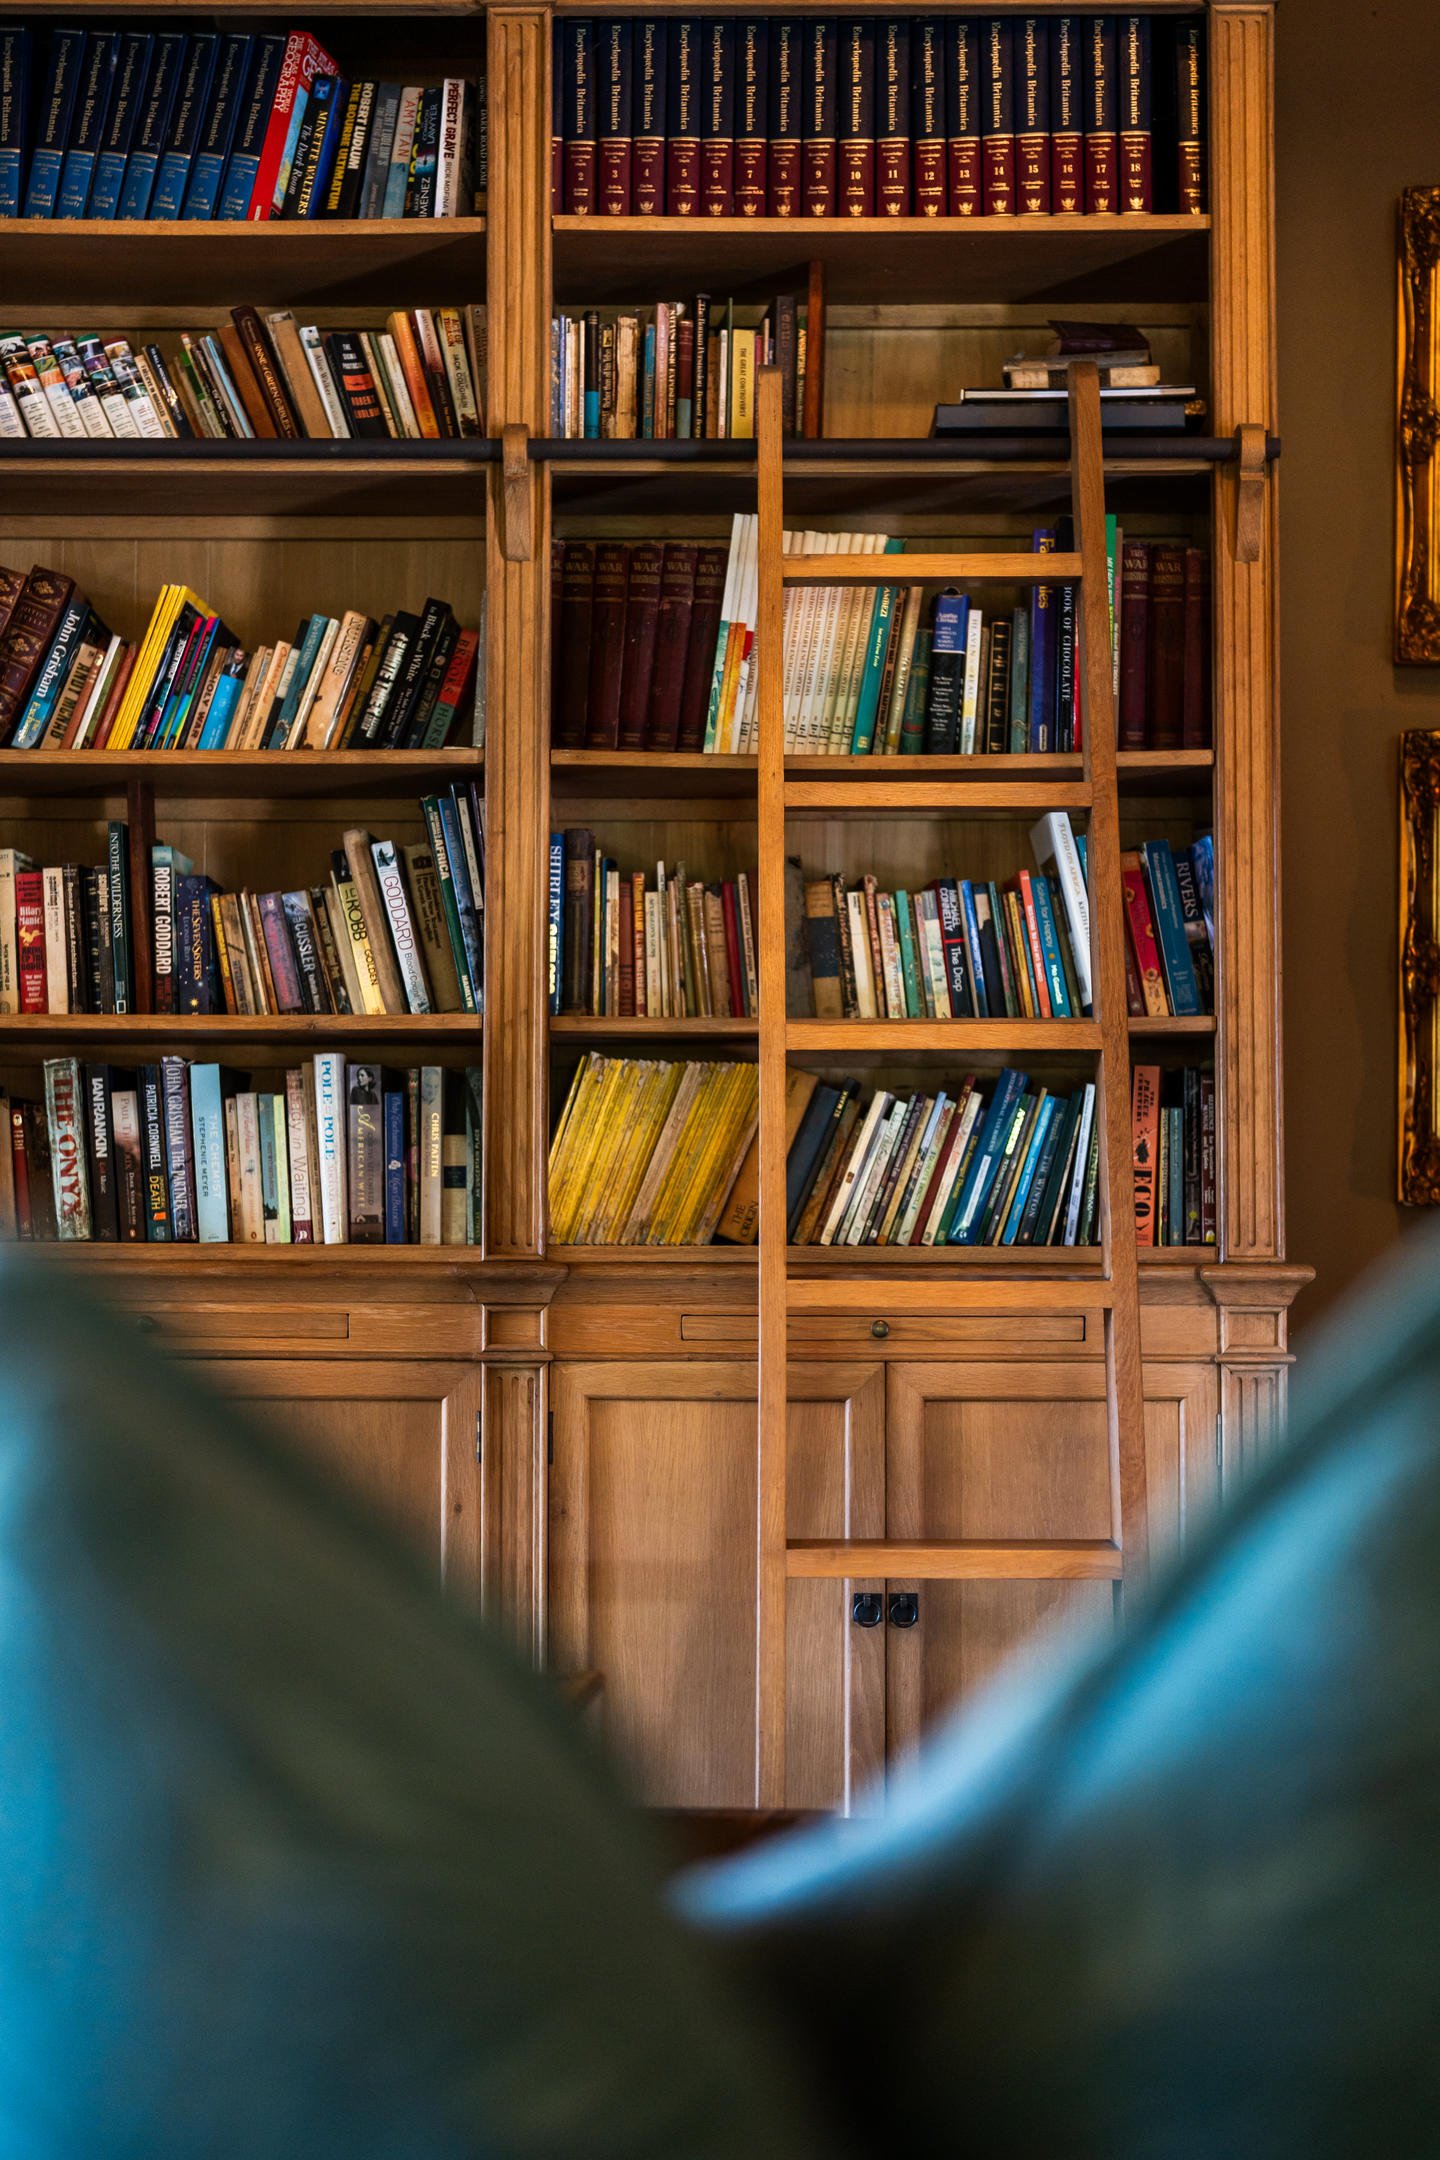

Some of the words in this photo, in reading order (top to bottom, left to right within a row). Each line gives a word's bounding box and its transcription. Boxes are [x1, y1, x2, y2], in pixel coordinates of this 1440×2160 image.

[274, 34, 297, 111] GEOGRAPHY
[350, 81, 361, 102] THE
[357, 81, 373, 125] ROBERT
[402, 99, 416, 126] AMY
[427, 103, 437, 144] LAWYER
[446, 82, 459, 124] PERFECT
[309, 110, 327, 162] MINETTE
[340, 103, 356, 147] BOURNE
[398, 130, 411, 157] TAN
[443, 127, 455, 158] GRAVE
[348, 125, 365, 170] LUDLUM
[298, 164, 315, 215] WALTERS
[327, 147, 348, 211] ULTIMATUM
[739, 359, 747, 375] GREAT
[737, 377, 748, 417] CONTROVERSY
[59, 609, 80, 644] John
[420, 613, 436, 641] Black
[1063, 617, 1071, 631] OF
[332, 616, 362, 677] NURSING
[405, 652, 423, 683] White
[443, 637, 467, 695] BROOKS
[37, 643, 66, 699] Grisham
[1061, 635, 1072, 701] CHOCOLATE
[202, 675, 217, 706] HOLY
[191, 710, 204, 738] WAR
[110, 831, 119, 854] INTO
[111, 854, 119, 871] THE
[435, 838, 449, 880] AFRICA
[156, 866, 169, 913] ROBERT
[546, 845, 563, 921] SHIRLEY
[1179, 860, 1198, 917] RIVERS
[110, 873, 123, 937] WILDERNESS
[347, 898, 366, 941] ROBB
[385, 875, 412, 951] GODDARD
[156, 915, 170, 974] GODDARD
[191, 946, 201, 979] SISTERS
[295, 921, 316, 971] CUSSLER
[404, 952, 415, 974] Blood
[950, 946, 960, 965] The
[364, 948, 376, 985] GOLDEN
[951, 966, 963, 992] Drop
[91, 1076, 104, 1101] IAN
[165, 1062, 183, 1092] JOHN
[321, 1060, 331, 1103] POLE
[55, 1071, 74, 1128] THE
[145, 1084, 157, 1120] PATRICIA
[166, 1094, 188, 1145] GRISHAM
[91, 1101, 109, 1158] RANKIN
[147, 1122, 160, 1169] CORNWELL
[197, 1116, 207, 1164] STEPHENIE
[209, 1113, 218, 1136] THE
[324, 1116, 334, 1160] POLE
[431, 1112, 439, 1140] CHRIS
[60, 1134, 80, 1217] ONYX
[171, 1149, 184, 1168] THE
[210, 1142, 222, 1199] CHEMIST
[430, 1143, 439, 1176] PATTEN
[149, 1175, 160, 1210] DEATH
[172, 1169, 188, 1210] PARTNER
[201, 1167, 209, 1197] MEYER
[289, 1155, 309, 1216] Waiting
[1029, 1176, 1044, 1218] WINTON
[1135, 1170, 1151, 1216] ECO
